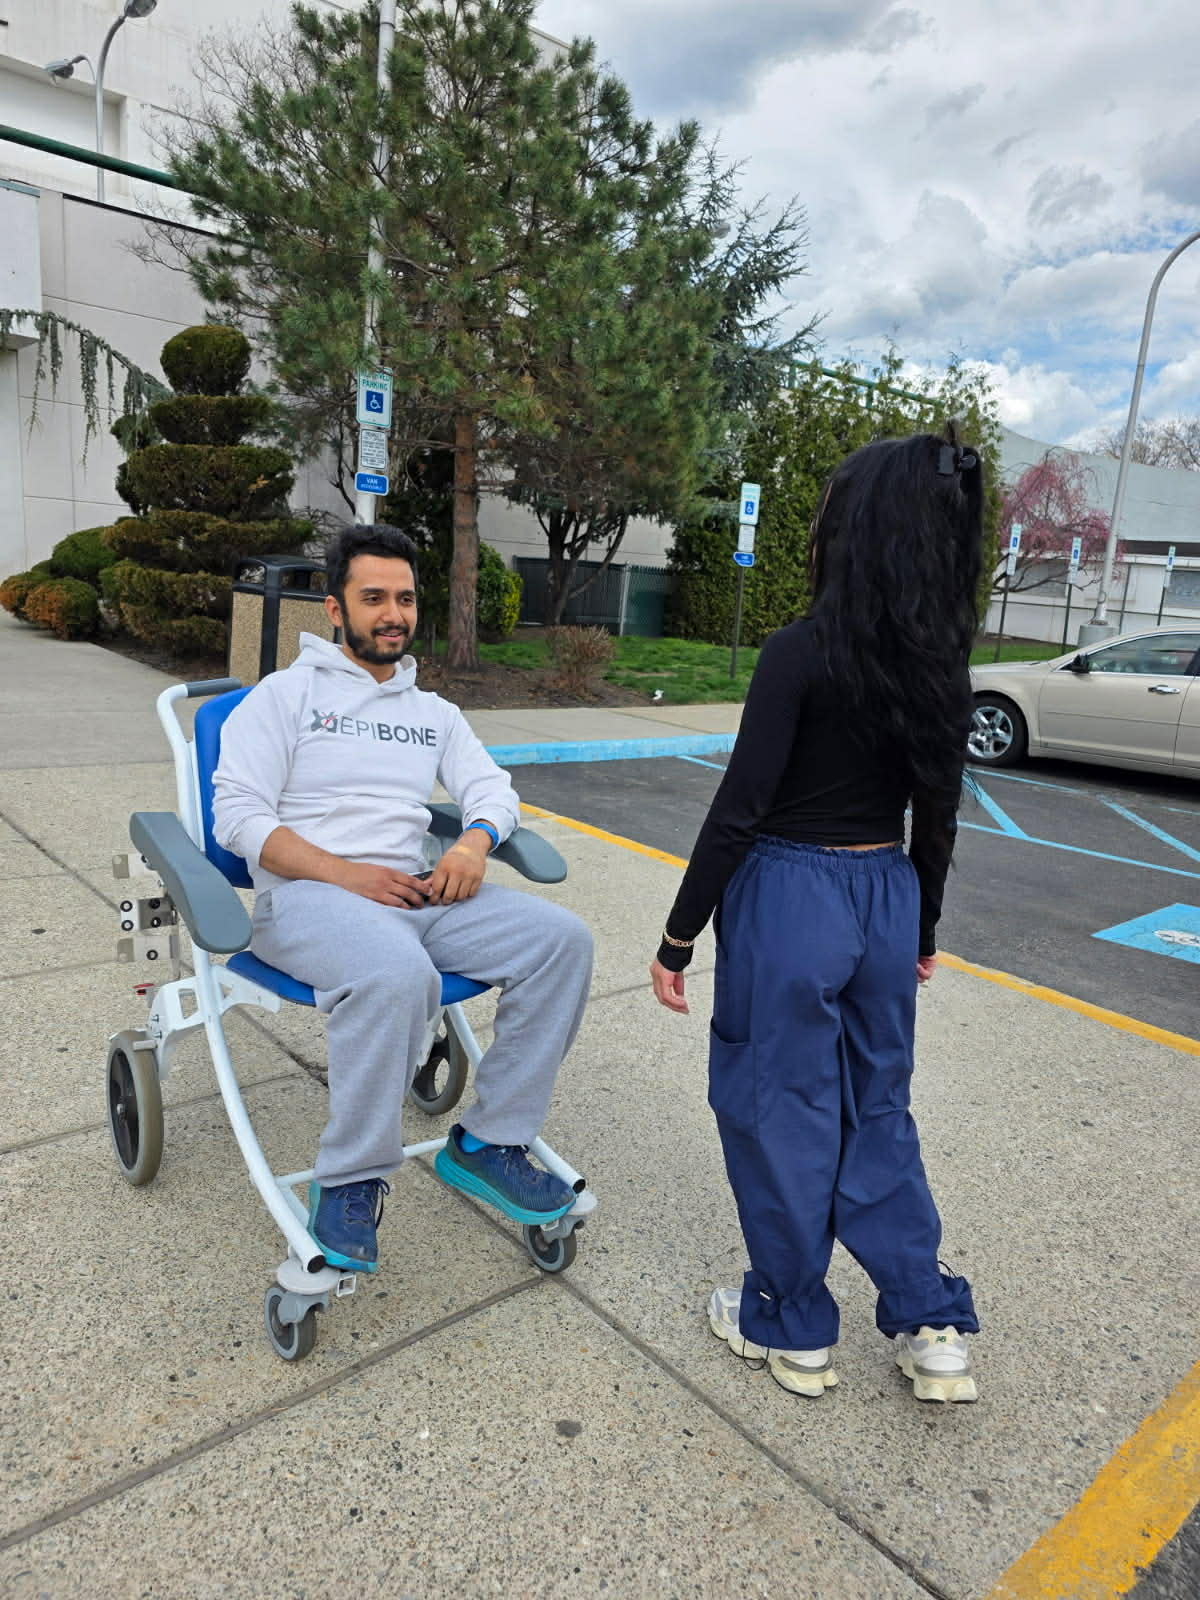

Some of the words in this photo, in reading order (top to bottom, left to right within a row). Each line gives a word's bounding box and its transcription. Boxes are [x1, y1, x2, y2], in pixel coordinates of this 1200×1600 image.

[362, 379, 388, 391] PARKING
[366, 476, 378, 485] VAN
[341, 715, 436, 746] EPIBONE
